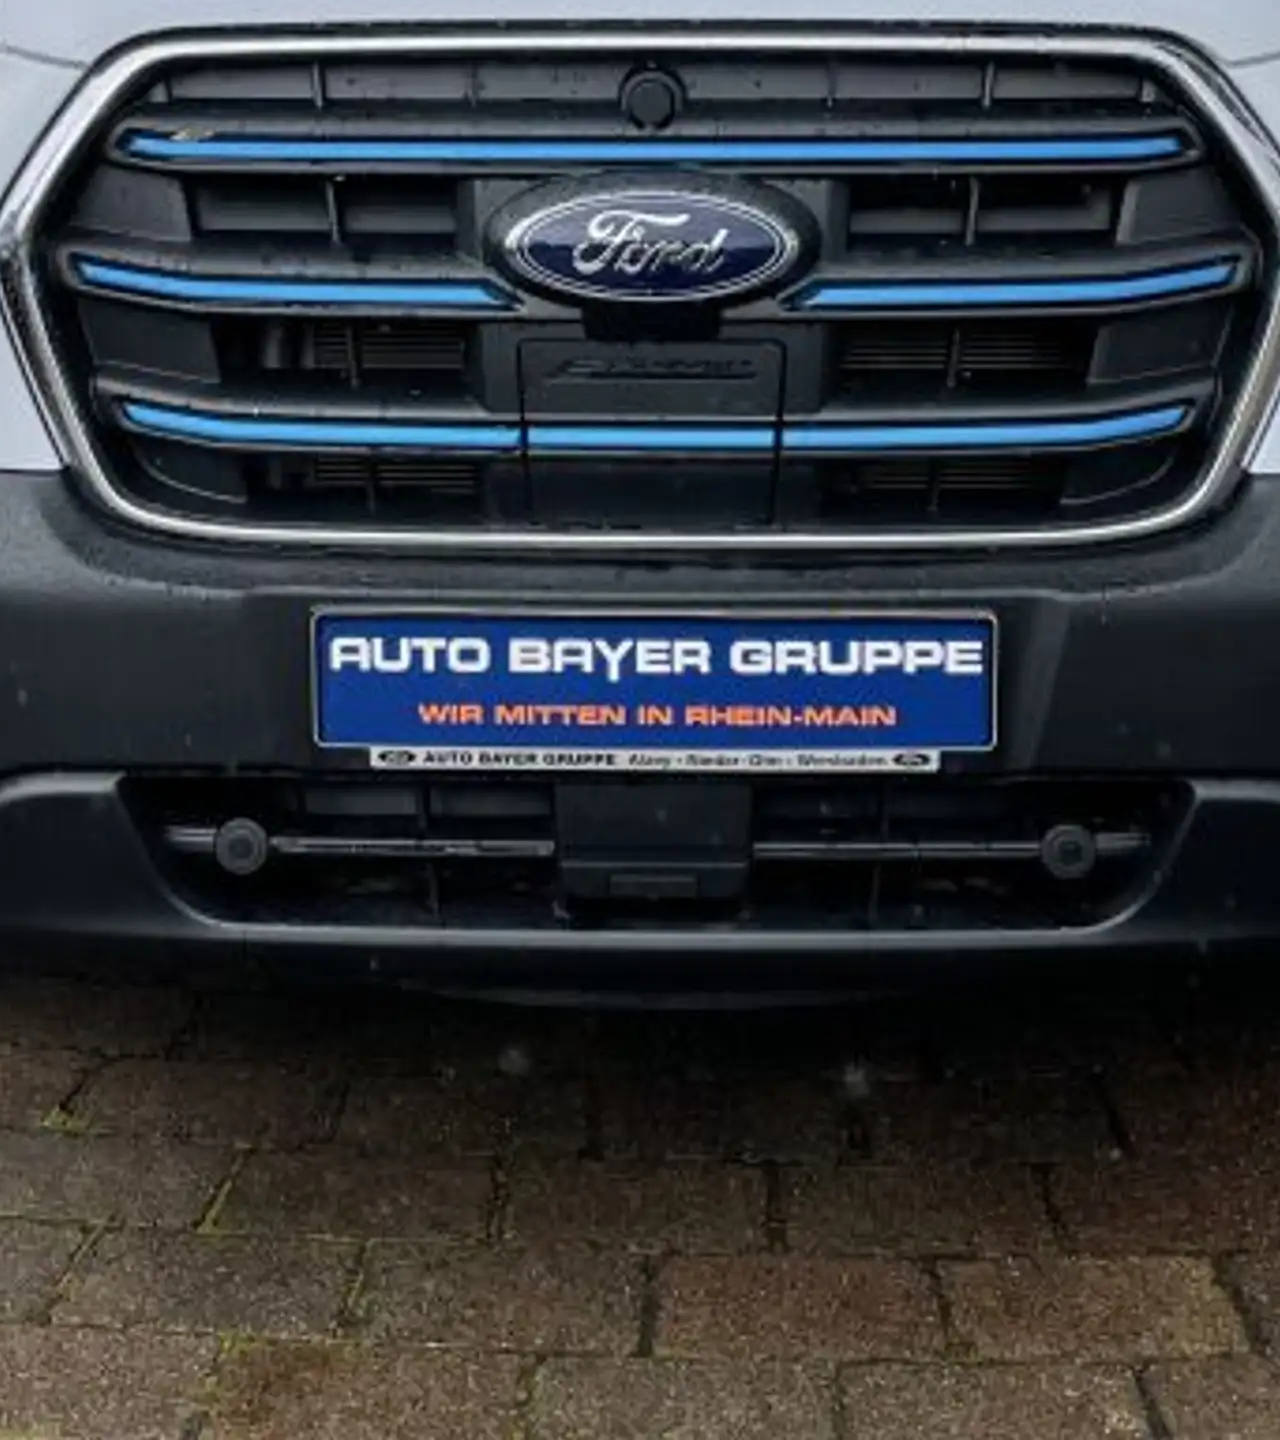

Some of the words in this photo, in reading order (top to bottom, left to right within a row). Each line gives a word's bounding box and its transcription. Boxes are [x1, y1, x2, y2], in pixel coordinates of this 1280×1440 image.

[572, 208, 731, 275] Ford
[329, 637, 491, 672] AUTO
[508, 637, 711, 681] BAYER
[730, 640, 983, 674] GRUPPE
[418, 704, 483, 725] WIR
[494, 705, 625, 725] MITTEN
[637, 705, 672, 726] IN
[685, 706, 897, 726] RHEIN-MAIN
